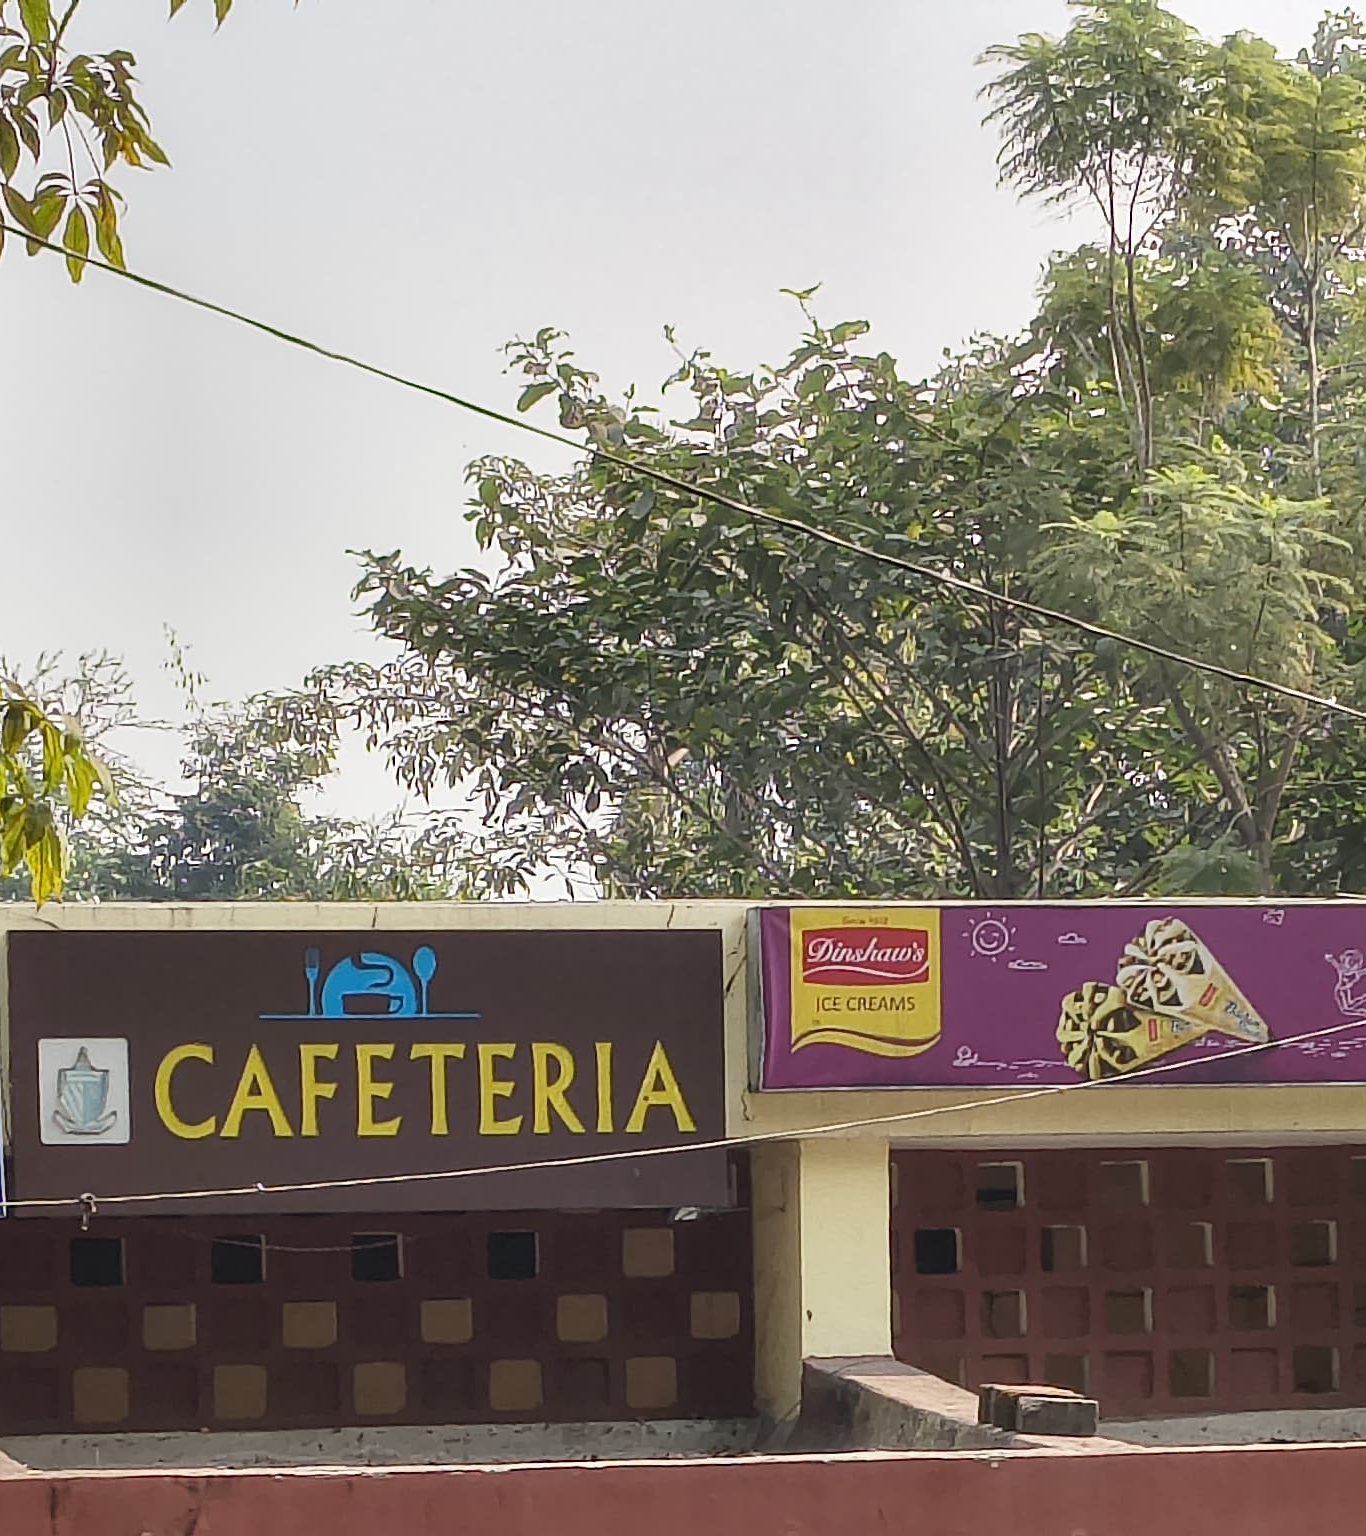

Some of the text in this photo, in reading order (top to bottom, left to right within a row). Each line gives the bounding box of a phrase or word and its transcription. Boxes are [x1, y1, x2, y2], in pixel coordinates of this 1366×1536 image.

[807, 936, 925, 963] Dinshaw's
[816, 996, 915, 1013] ICE CREAMS
[153, 1041, 697, 1139] CAFETERIA
